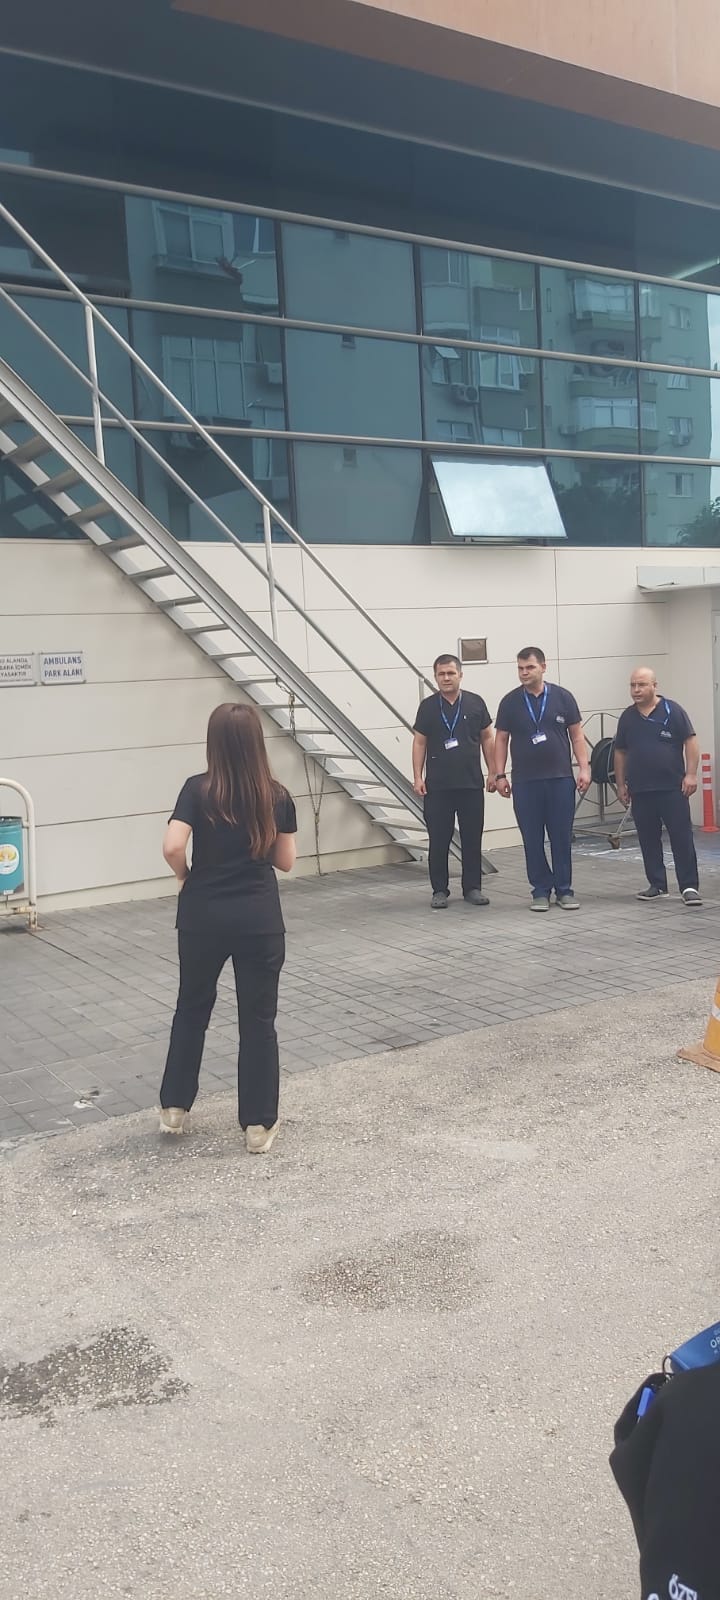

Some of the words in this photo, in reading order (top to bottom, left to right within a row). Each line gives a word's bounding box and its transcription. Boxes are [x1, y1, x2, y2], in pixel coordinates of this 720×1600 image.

[44, 656, 82, 665] AMBULANS
[44, 669, 61, 678] PARK
[63, 668, 83, 677] ALANI
